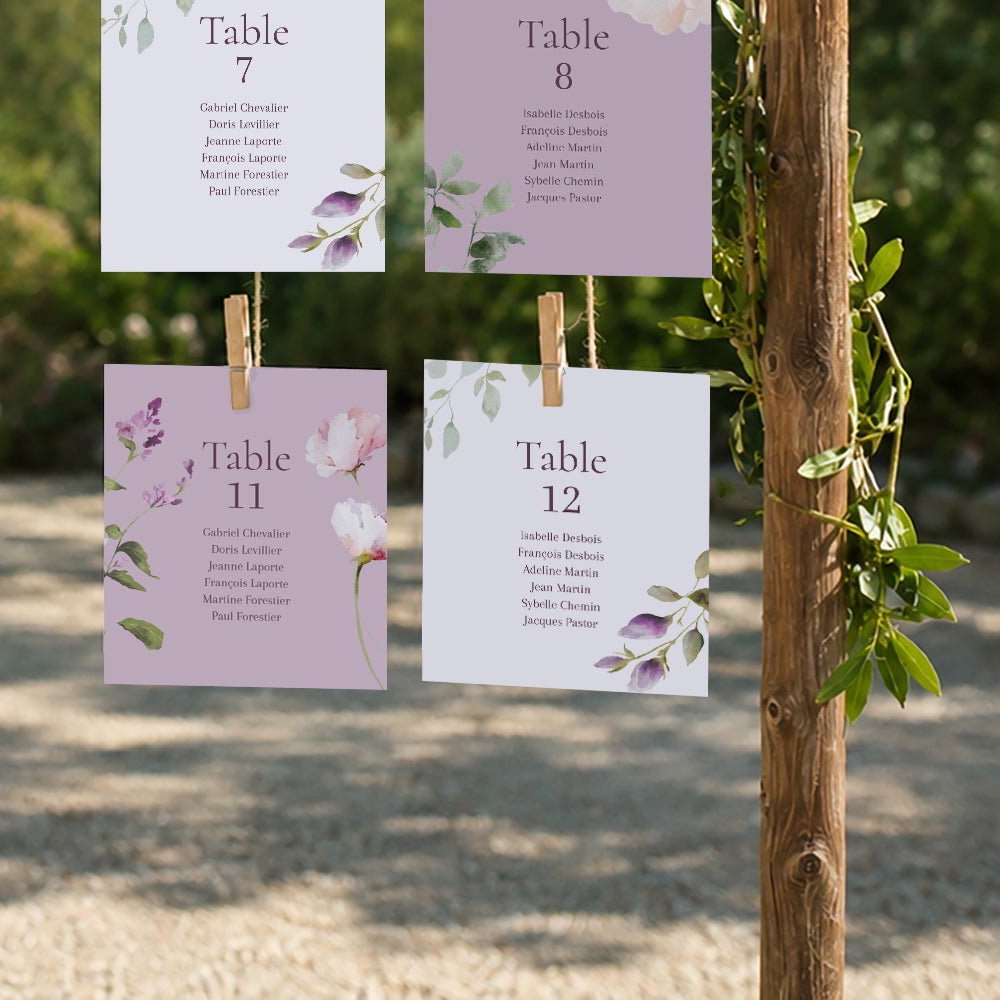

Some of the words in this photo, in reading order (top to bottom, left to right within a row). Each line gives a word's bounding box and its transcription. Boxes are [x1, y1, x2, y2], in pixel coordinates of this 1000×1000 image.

[199, 13, 289, 46] Table
[518, 17, 609, 51] Table
[236, 56, 253, 83] 7
[555, 62, 573, 90] 8
[200, 102, 237, 112] Gabriel
[240, 102, 289, 113] Chevalier
[523, 109, 562, 119] Isabelle
[565, 109, 605, 120] Desbois
[209, 119, 236, 129] Doris
[239, 119, 280, 129] Levillier
[521, 125, 565, 138] François
[568, 125, 608, 137] Desbois
[204, 136, 241, 148] Jeanne
[244, 136, 282, 148] Laporte
[202, 153, 245, 165] François
[249, 153, 287, 165] Laporte
[200, 169, 240, 180] Martine
[243, 169, 289, 180] Forestier
[524, 175, 561, 188] Sybelle
[563, 176, 604, 187] Chemin
[209, 186, 231, 196] Paul
[234, 186, 280, 196] Forestier
[526, 191, 566, 205] Jacques
[569, 192, 602, 203] Pastor
[202, 439, 291, 472] Table
[516, 439, 607, 474] Table
[228, 482, 264, 510] 11
[542, 485, 581, 514] 12
[203, 527, 239, 538] Gabriel
[242, 528, 291, 539] Chevalier
[521, 530, 559, 542] Isabelle
[563, 532, 602, 544] Desbois
[211, 544, 239, 555] Doris
[242, 544, 282, 555] Levillier
[518, 547, 562, 561] François
[565, 549, 604, 562] Desbois
[207, 560, 243, 572] Jeanne
[246, 561, 284, 574] Laporte
[522, 564, 562, 576] Adeline
[565, 566, 599, 578] Martin
[204, 577, 248, 590] François
[251, 578, 289, 591] Laporte
[529, 581, 553, 593] Jean
[557, 583, 591, 594] Martin
[203, 593, 243, 604] Martine
[246, 595, 291, 605] Forestier
[521, 598, 558, 611] Sybelle
[560, 600, 600, 612] Chemin
[212, 610, 233, 621] Paul
[237, 611, 282, 622] Forestier
[522, 615, 563, 629] Jacques
[566, 617, 598, 629] Pastor
